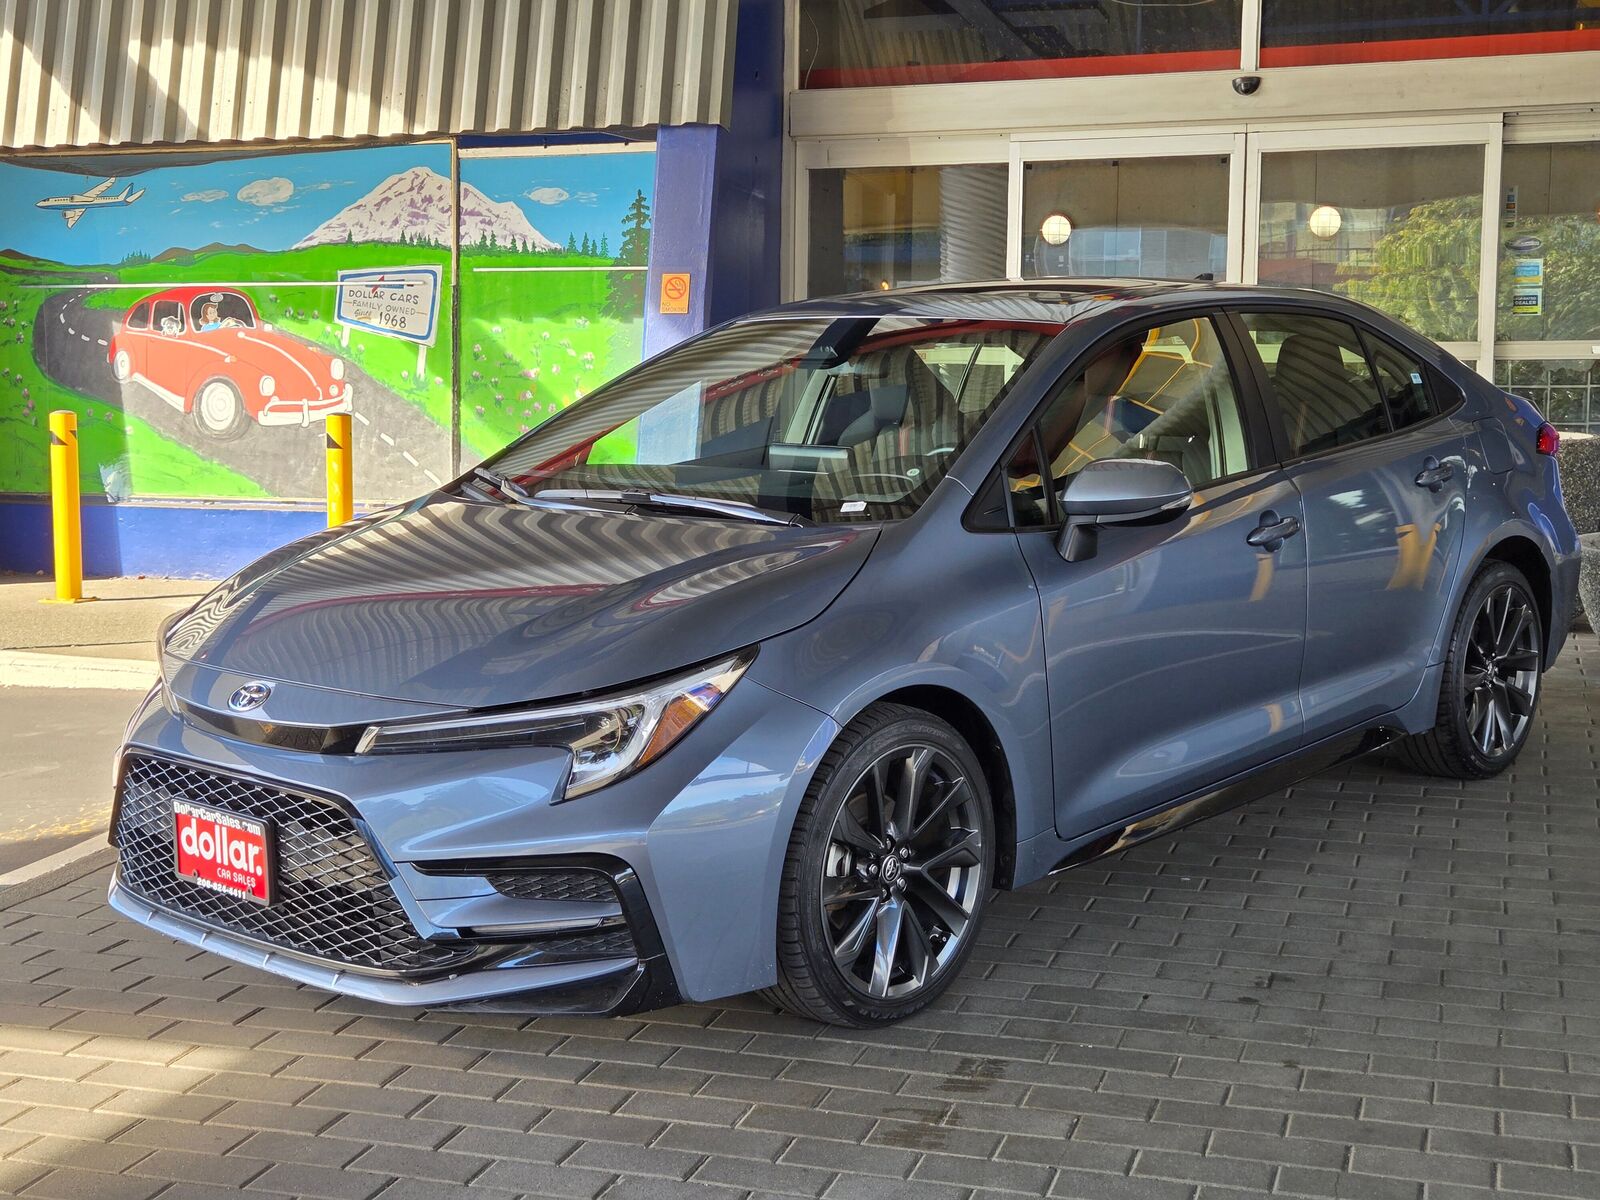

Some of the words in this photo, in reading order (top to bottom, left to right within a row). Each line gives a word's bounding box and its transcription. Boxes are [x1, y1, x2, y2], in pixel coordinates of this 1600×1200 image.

[349, 290, 385, 300] DOLLAR
[390, 292, 419, 304] CARS
[352, 300, 382, 310] FAMILY
[386, 304, 416, 316] OWNED
[379, 312, 407, 328] 1968
[217, 868, 232, 880] CAR
[233, 872, 256, 888] SALES
